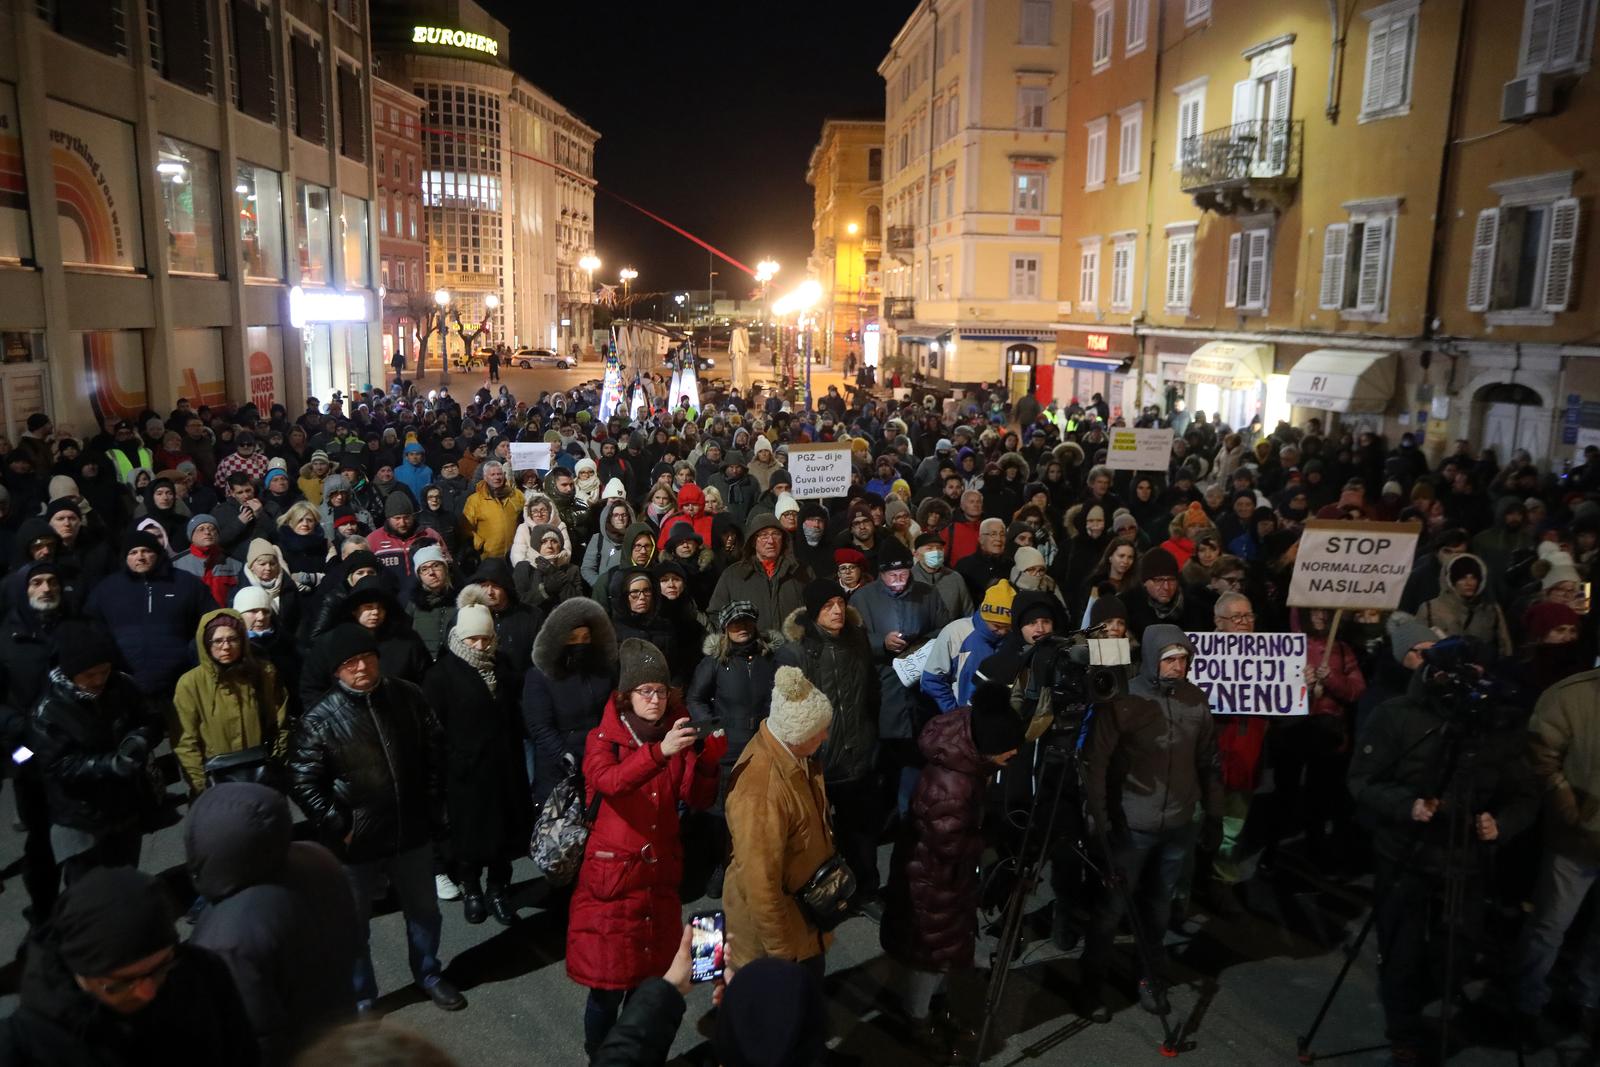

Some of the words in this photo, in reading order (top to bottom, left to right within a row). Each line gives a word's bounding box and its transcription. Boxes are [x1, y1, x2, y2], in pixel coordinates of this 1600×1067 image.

[412, 26, 498, 57] EUROHERC
[251, 376, 274, 394] URGER
[1310, 376, 1328, 392] RI
[252, 393, 274, 417] ING
[824, 453, 833, 461] di
[835, 453, 843, 461] je
[806, 464, 834, 472] čuvar?
[795, 474, 817, 484] Čuva
[825, 475, 846, 483] ovce
[803, 486, 845, 496] galebove?
[1325, 536, 1391, 555] STOP
[1301, 561, 1407, 575] NORMALIZACIJI
[1308, 578, 1387, 594] NASILJA
[982, 604, 1012, 617] BUR
[1188, 633, 1305, 658] RUMPIRANOJ
